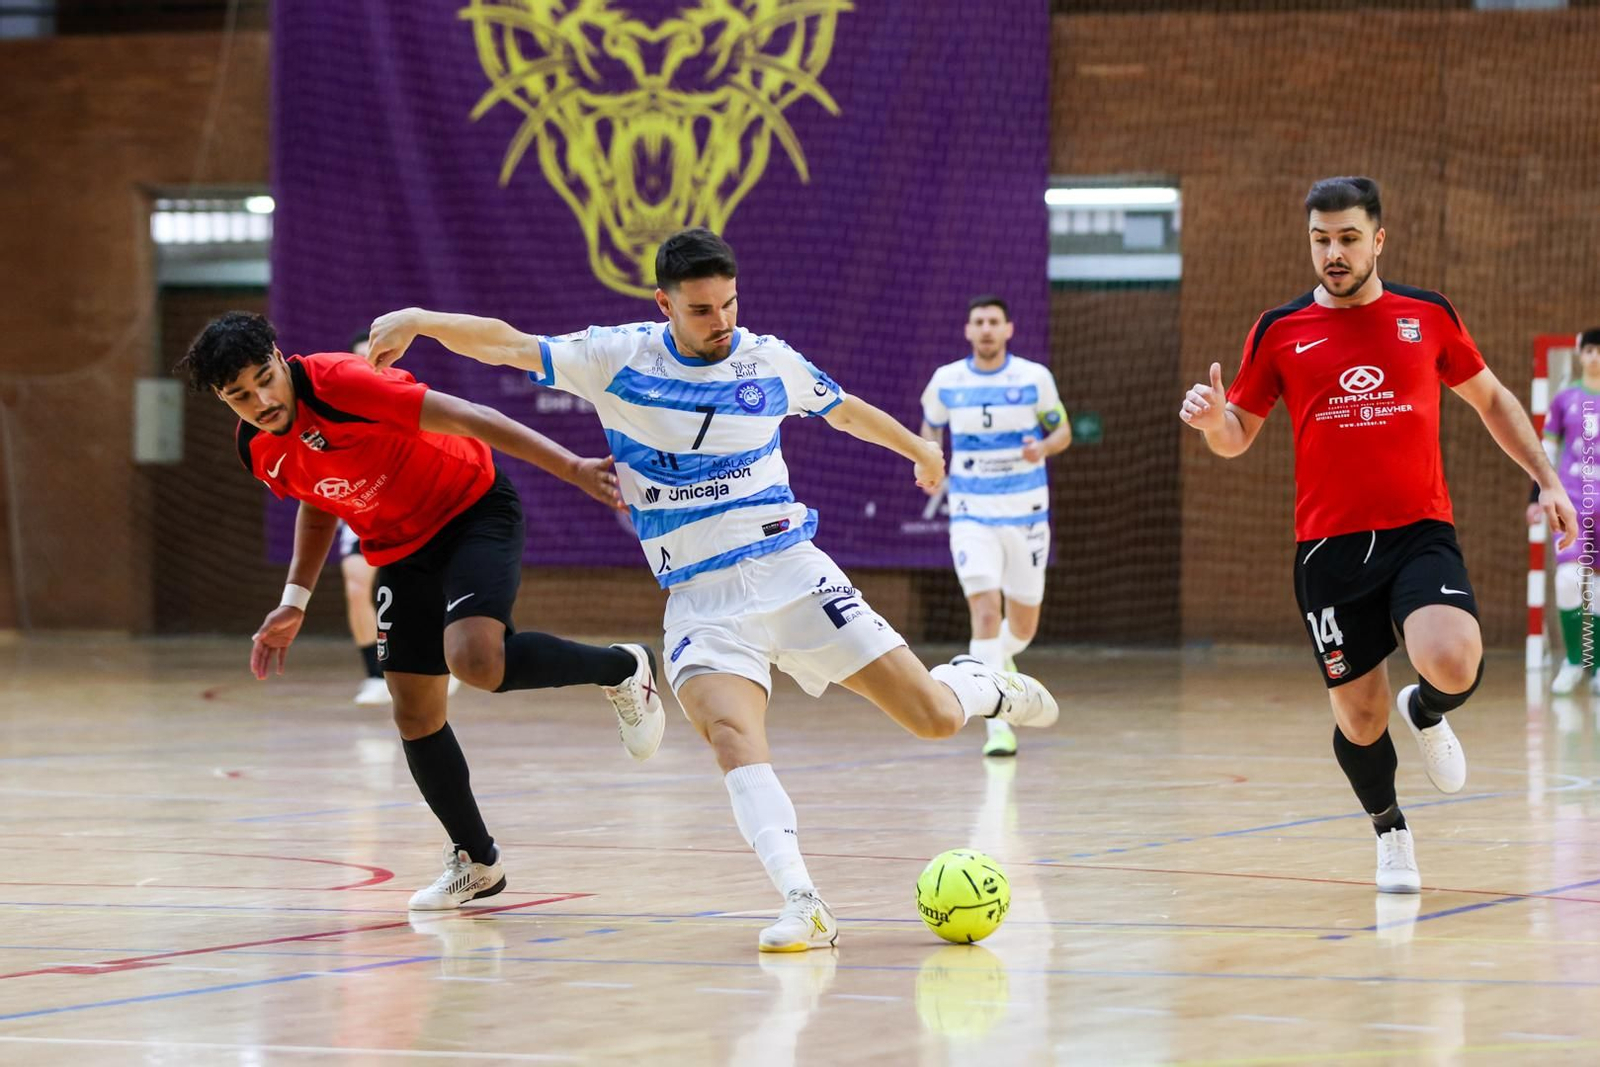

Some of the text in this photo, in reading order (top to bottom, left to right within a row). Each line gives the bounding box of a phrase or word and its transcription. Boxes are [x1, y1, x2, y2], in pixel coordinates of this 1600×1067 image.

[730, 360, 758, 371] Silver
[735, 368, 757, 380] gold
[1329, 391, 1394, 404] MAXUS
[983, 403, 992, 428] 5
[1374, 404, 1413, 414] SAVHER
[691, 406, 716, 450] 7
[361, 474, 388, 500] SAVHER
[668, 481, 730, 501] Unicaja
[377, 585, 393, 630] 2
[1307, 606, 1344, 653] 14
